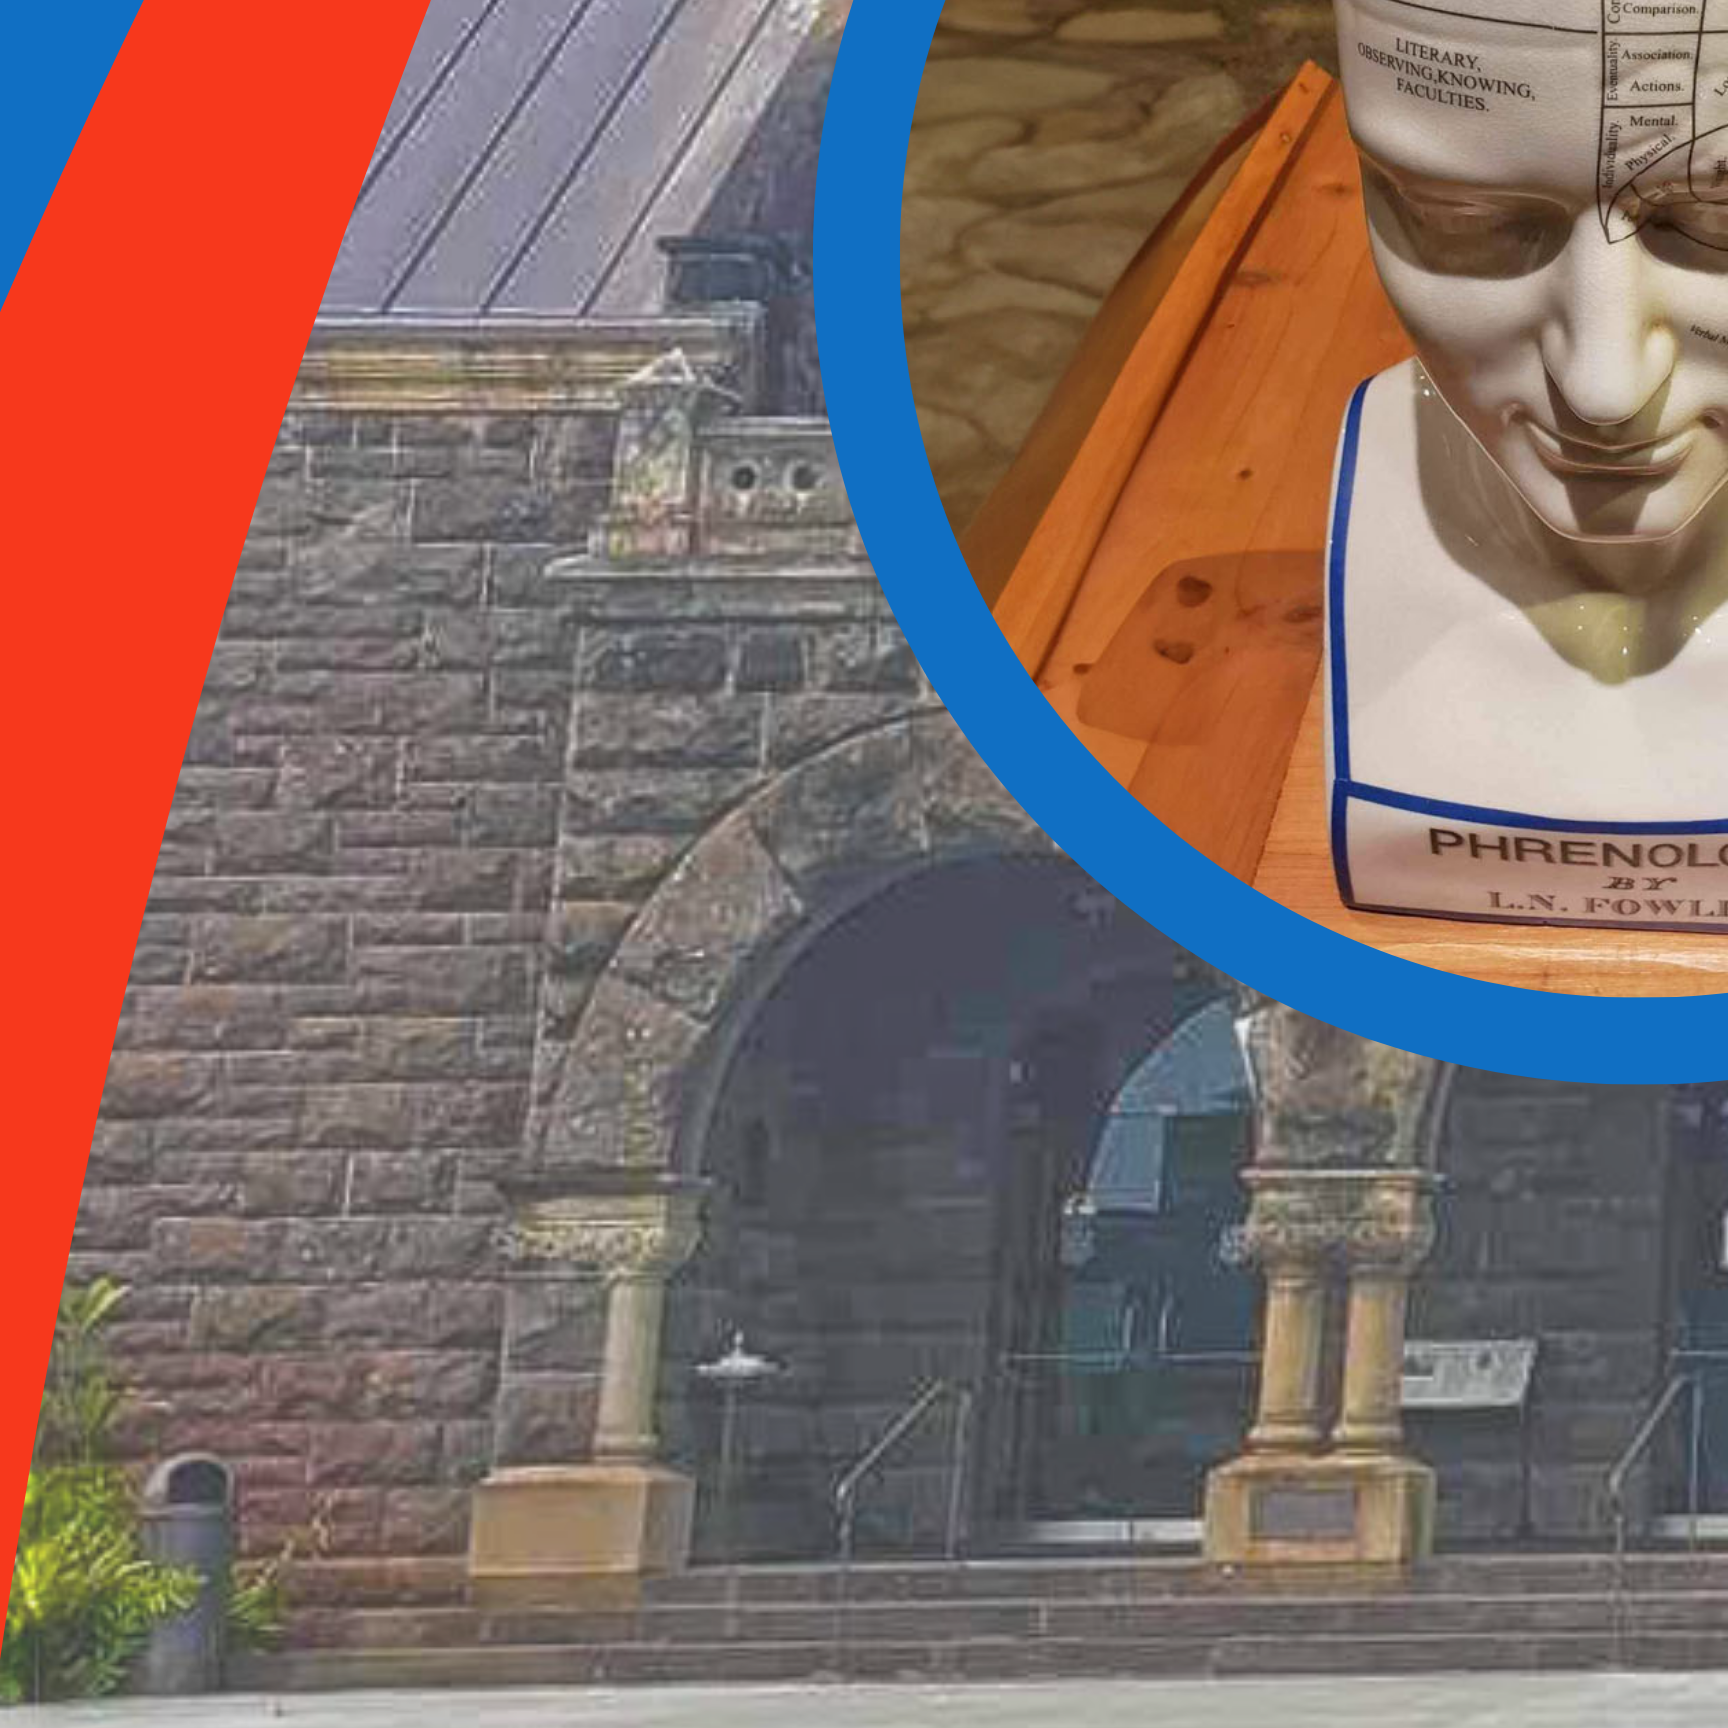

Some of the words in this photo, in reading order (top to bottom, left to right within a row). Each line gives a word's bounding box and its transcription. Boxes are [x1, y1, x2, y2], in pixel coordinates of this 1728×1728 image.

[1623, 2, 1699, 17] Comparison.
[1396, 38, 1481, 72] LITERARY,
[1621, 49, 1694, 61] Association.
[1607, 38, 1620, 101] Eventuality.
[1630, 80, 1684, 92] Actions.
[1397, 78, 1490, 112] FACULTIES.
[1630, 115, 1678, 127] Mental.
[1624, 134, 1676, 171] Physical.
[1602, 876, 1678, 890] BY
